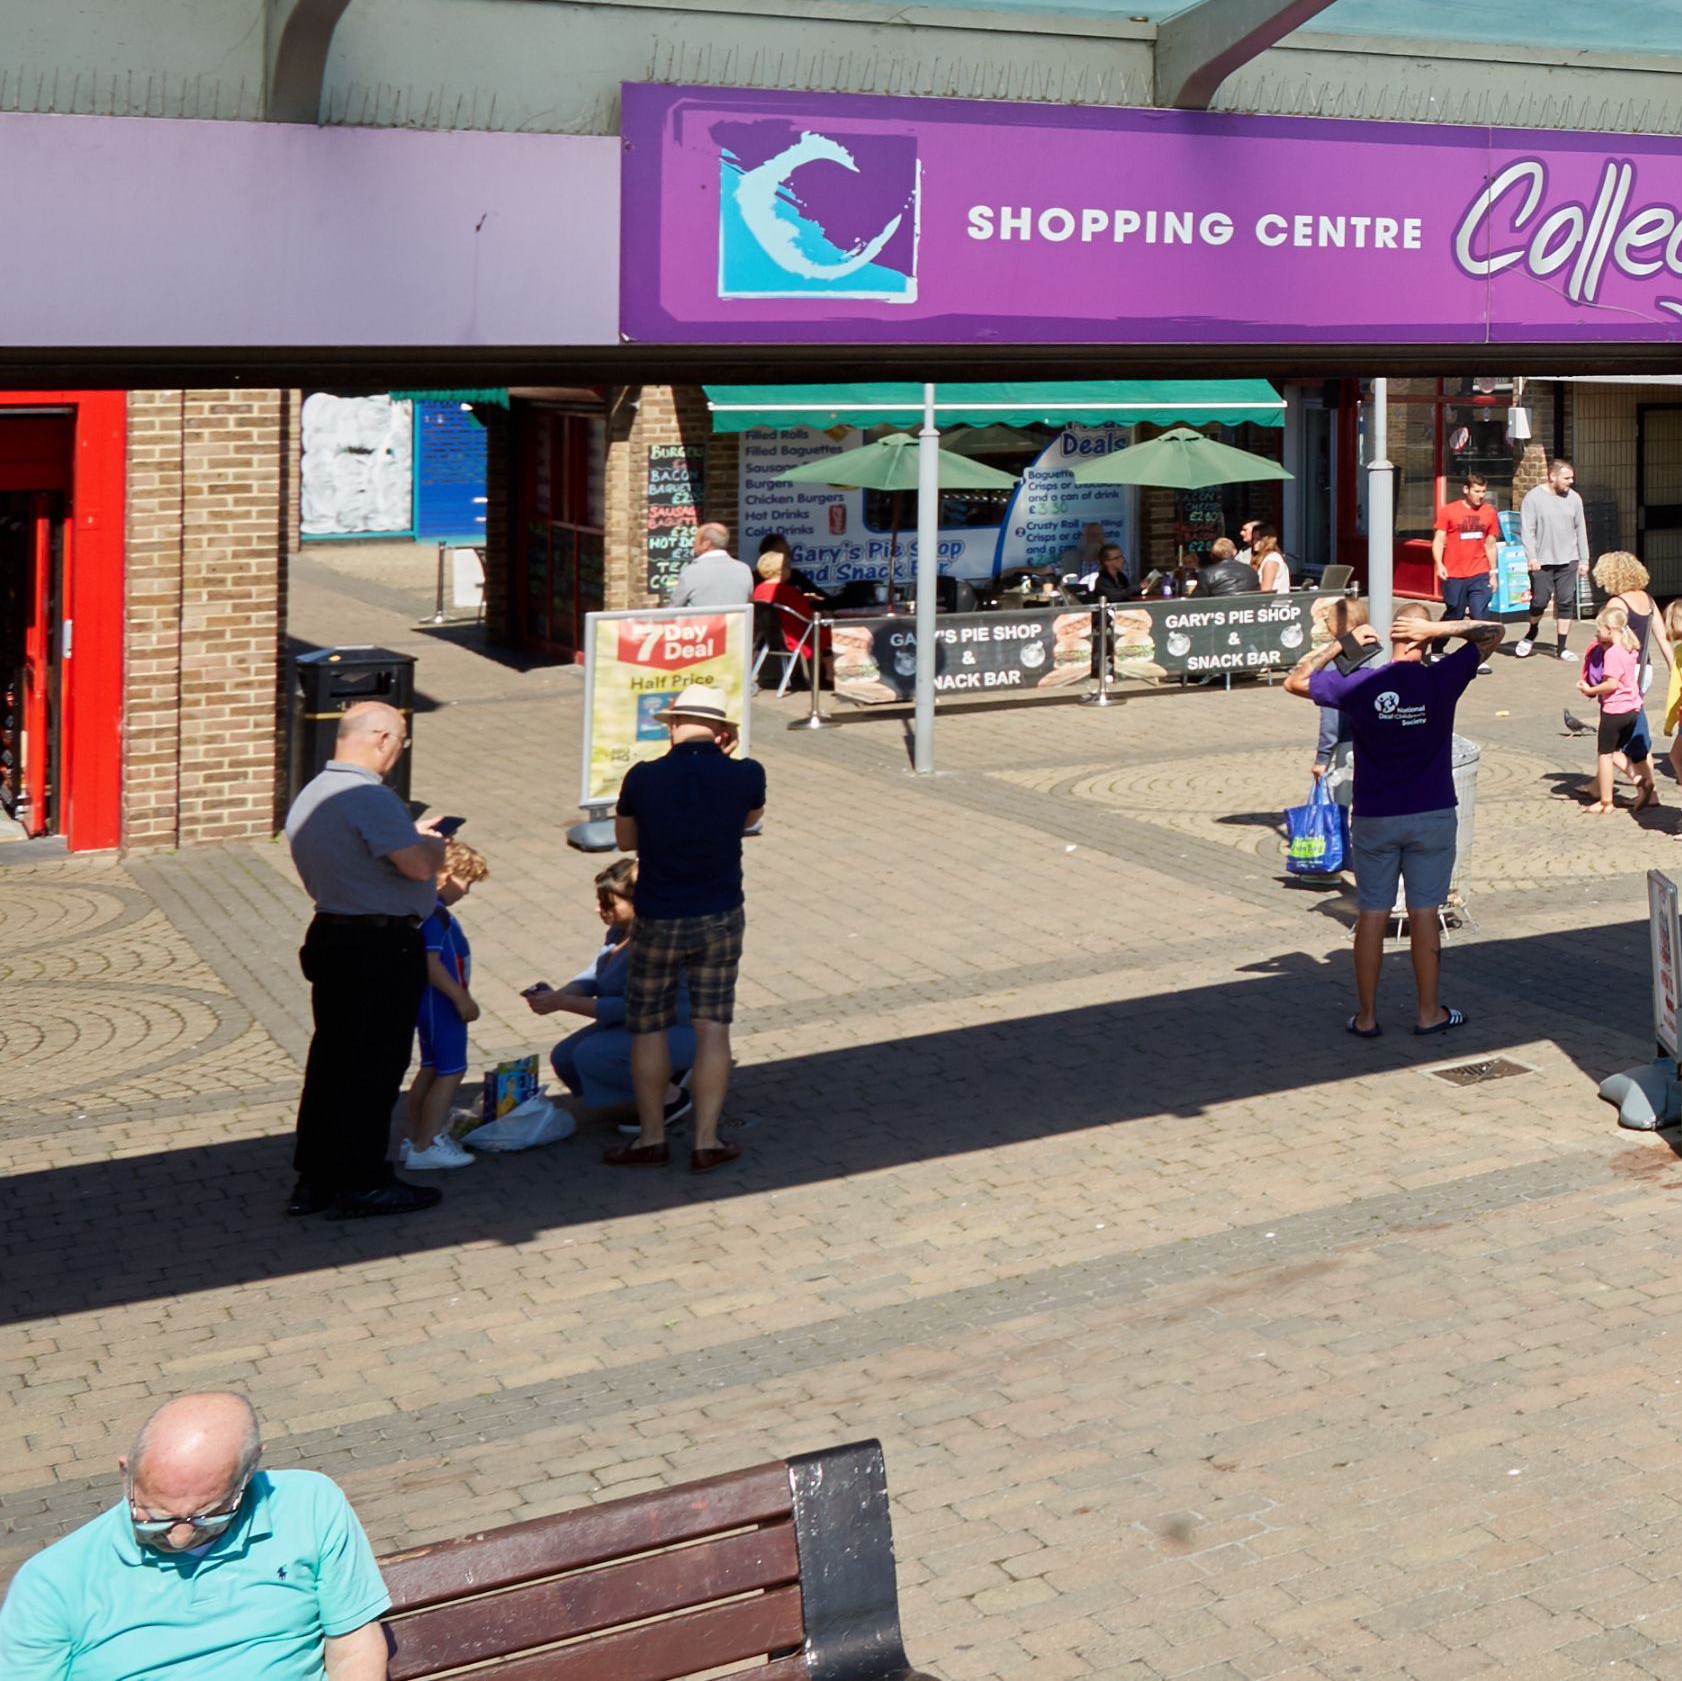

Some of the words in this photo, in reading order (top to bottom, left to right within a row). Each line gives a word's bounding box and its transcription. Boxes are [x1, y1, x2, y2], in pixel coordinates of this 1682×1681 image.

[967, 204, 1235, 246] SHOPPING
[1255, 213, 1423, 249] CENTRE
[781, 429, 809, 440] Rolls
[745, 445, 777, 457] Filled
[781, 444, 844, 458] Baguettes
[1062, 432, 1128, 456] Deals
[745, 480, 793, 491] Burgers
[1028, 481, 1057, 492] Crisps
[1061, 482, 1073, 490] or
[745, 494, 794, 505] Chicken
[797, 493, 844, 506] Burgers
[1028, 492, 1048, 502] and
[1061, 493, 1079, 502] can
[1081, 491, 1092, 500] of
[1094, 490, 1119, 500] drink
[745, 510, 768, 521] Hot
[771, 509, 810, 520] Drinks
[745, 525, 773, 537] Cold
[776, 525, 815, 536] Drinks
[1027, 520, 1056, 533] Crusty
[1061, 520, 1079, 529] Roll
[1027, 532, 1056, 543] Crisps
[792, 543, 862, 564] Gary's
[868, 542, 904, 558] Pie
[910, 540, 963, 562] Sop
[1026, 544, 1046, 554] and
[836, 563, 904, 581] Snack
[1165, 612, 1225, 629] GARY'S
[1229, 609, 1254, 625] PIE
[1257, 606, 1302, 624] SHOP
[664, 623, 709, 643] Day
[889, 627, 958, 648] GA'S
[961, 626, 990, 644] PIE
[998, 623, 1043, 641] SHOP
[1228, 632, 1241, 646] &
[632, 624, 665, 662] 7
[664, 638, 714, 660] Deal
[962, 650, 976, 665] &
[1187, 652, 1243, 670] SNACK
[1246, 650, 1281, 666] BAR
[630, 675, 668, 690] Half
[672, 673, 715, 689] Price
[934, 672, 981, 690] NACK
[983, 670, 1021, 687] BAR
